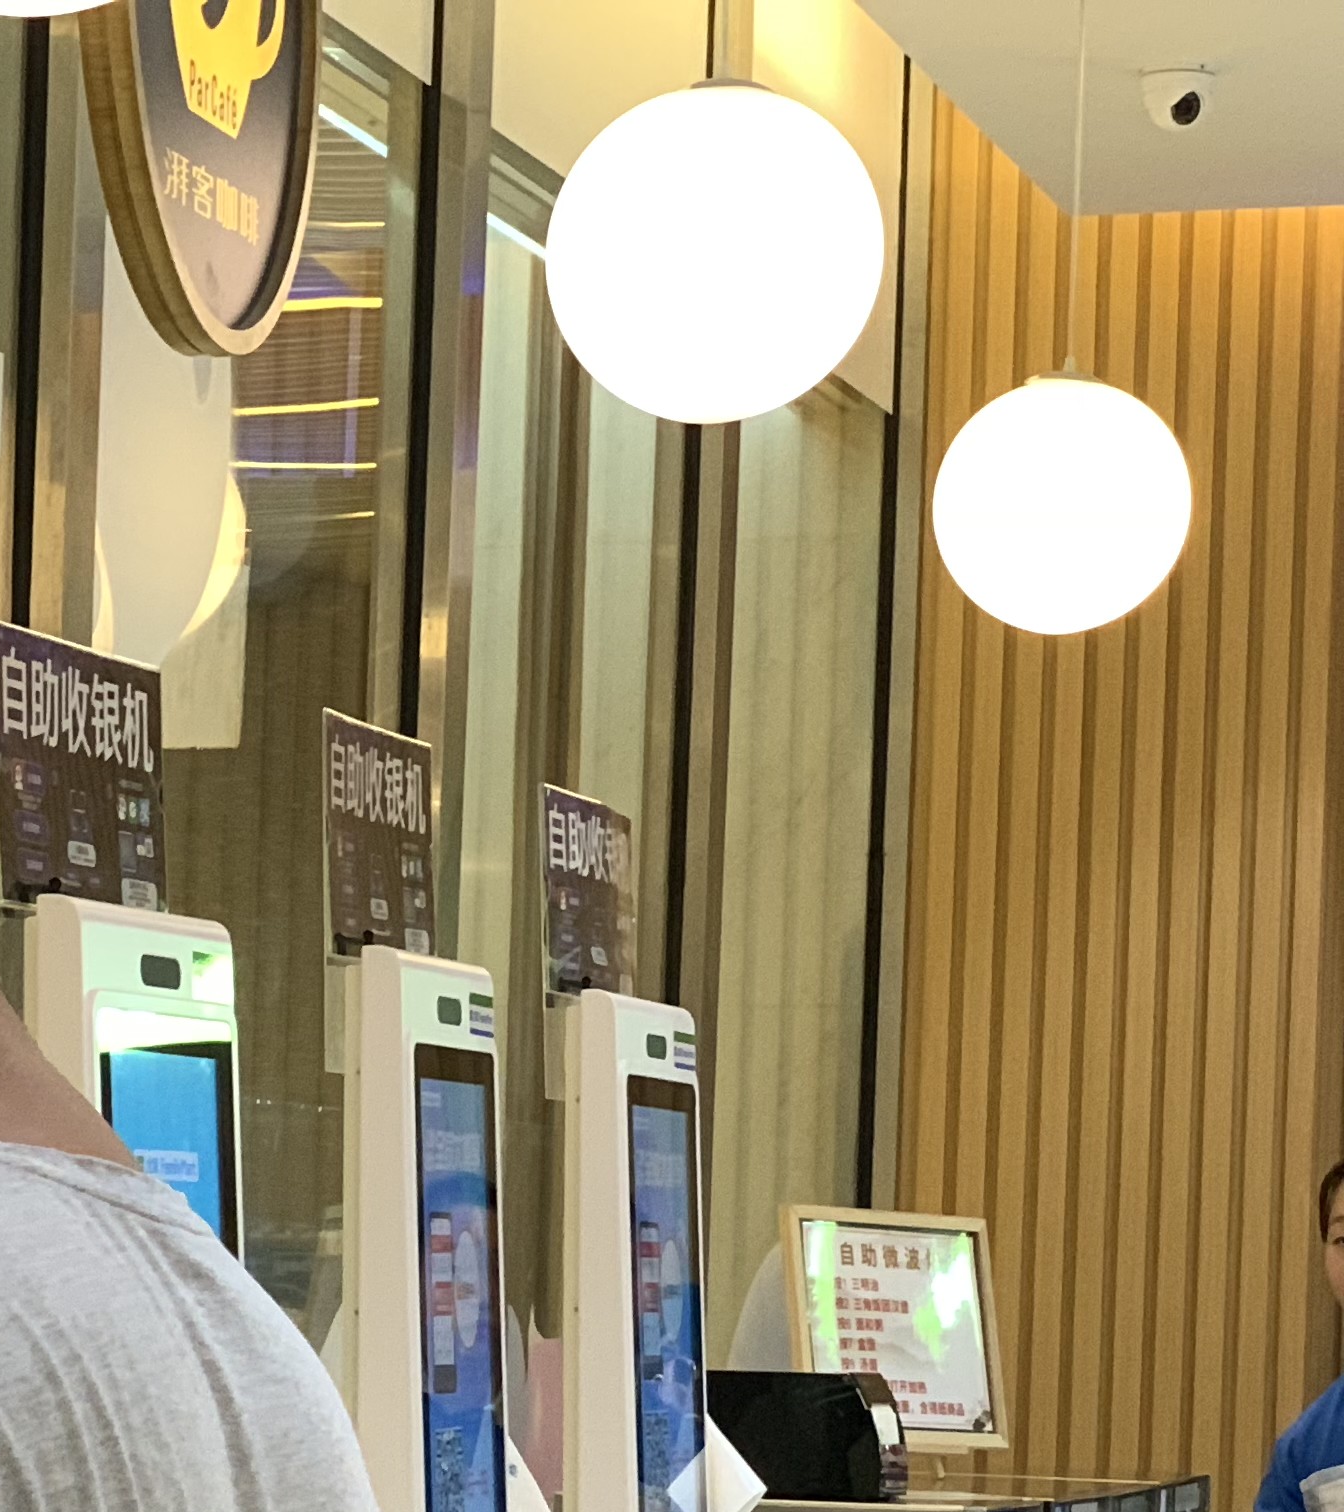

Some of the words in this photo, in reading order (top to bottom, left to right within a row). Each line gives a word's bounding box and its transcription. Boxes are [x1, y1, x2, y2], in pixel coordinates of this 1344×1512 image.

[189, 59, 237, 130] ParCafé
[164, 147, 259, 246] 湃客咖啡
[2, 647, 154, 773] 自助收银机
[331, 734, 426, 834] 自助收银机
